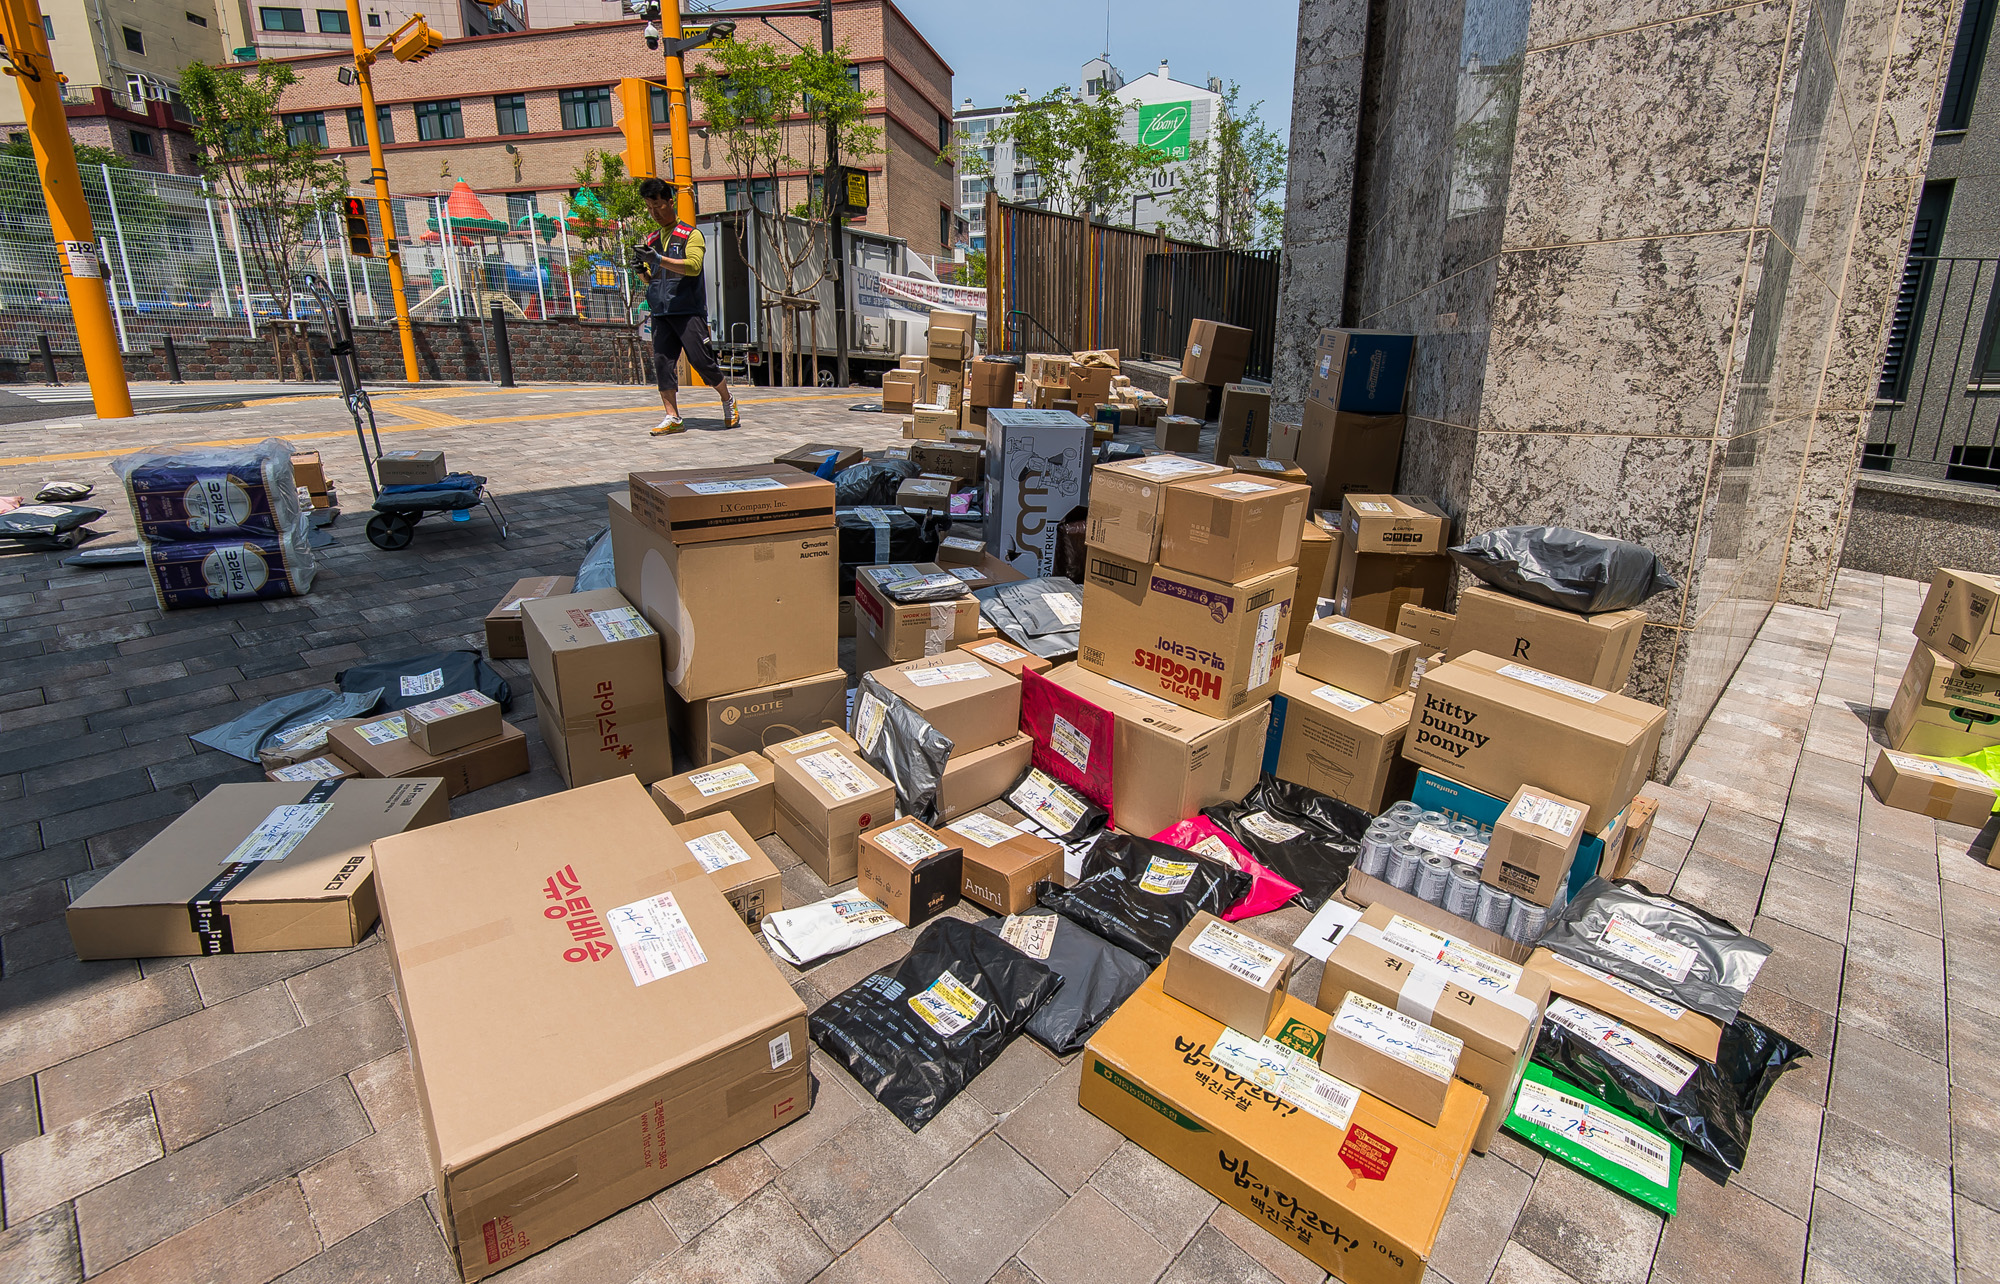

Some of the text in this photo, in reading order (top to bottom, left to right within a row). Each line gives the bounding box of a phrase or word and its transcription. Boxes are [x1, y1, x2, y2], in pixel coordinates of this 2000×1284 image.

[1151, 172, 1175, 188] 101
[67, 242, 96, 256] 과외
[207, 482, 228, 526] 크리넥스
[720, 500, 788, 513] LX Company, Inc.
[801, 541, 828, 550] Gmarket
[225, 550, 246, 592] 크리넥스
[1157, 637, 1225, 671] 맥스드라이
[1511, 636, 1532, 661] R
[1134, 648, 1223, 701] HUGGIES
[1160, 677, 1201, 701] 하기스
[593, 681, 621, 753] 라이스타
[743, 699, 784, 715] LOTTE
[1424, 692, 1478, 726] kitty
[1415, 728, 1470, 759] pony
[1420, 710, 1490, 749] bunny
[1413, 746, 1466, 770] www.kittybunnypony.com
[876, 896, 889, 909] LUSH
[965, 878, 1003, 907] Amini
[543, 864, 614, 962] 슈팅배송
[616, 907, 661, 942] 124-911
[1354, 995, 1364, 1005] SS
[1366, 1002, 1383, 1014] 494
[1398, 1016, 1417, 1028] 480
[1274, 1043, 1292, 1056] 480
[1174, 1035, 1215, 1071] 밥이
[1223, 1068, 1299, 1119] 다르다!
[1195, 1070, 1253, 1113] 백진주쌀
[641, 1112, 652, 1169] www.11st.co.kr
[653, 1099, 668, 1170] 고객센터 1599-3883
[1219, 1150, 1359, 1253] 밥이 다르다!
[499, 1215, 517, 1259] 소비자중심
[1250, 1194, 1313, 1246] 백진주쌀
